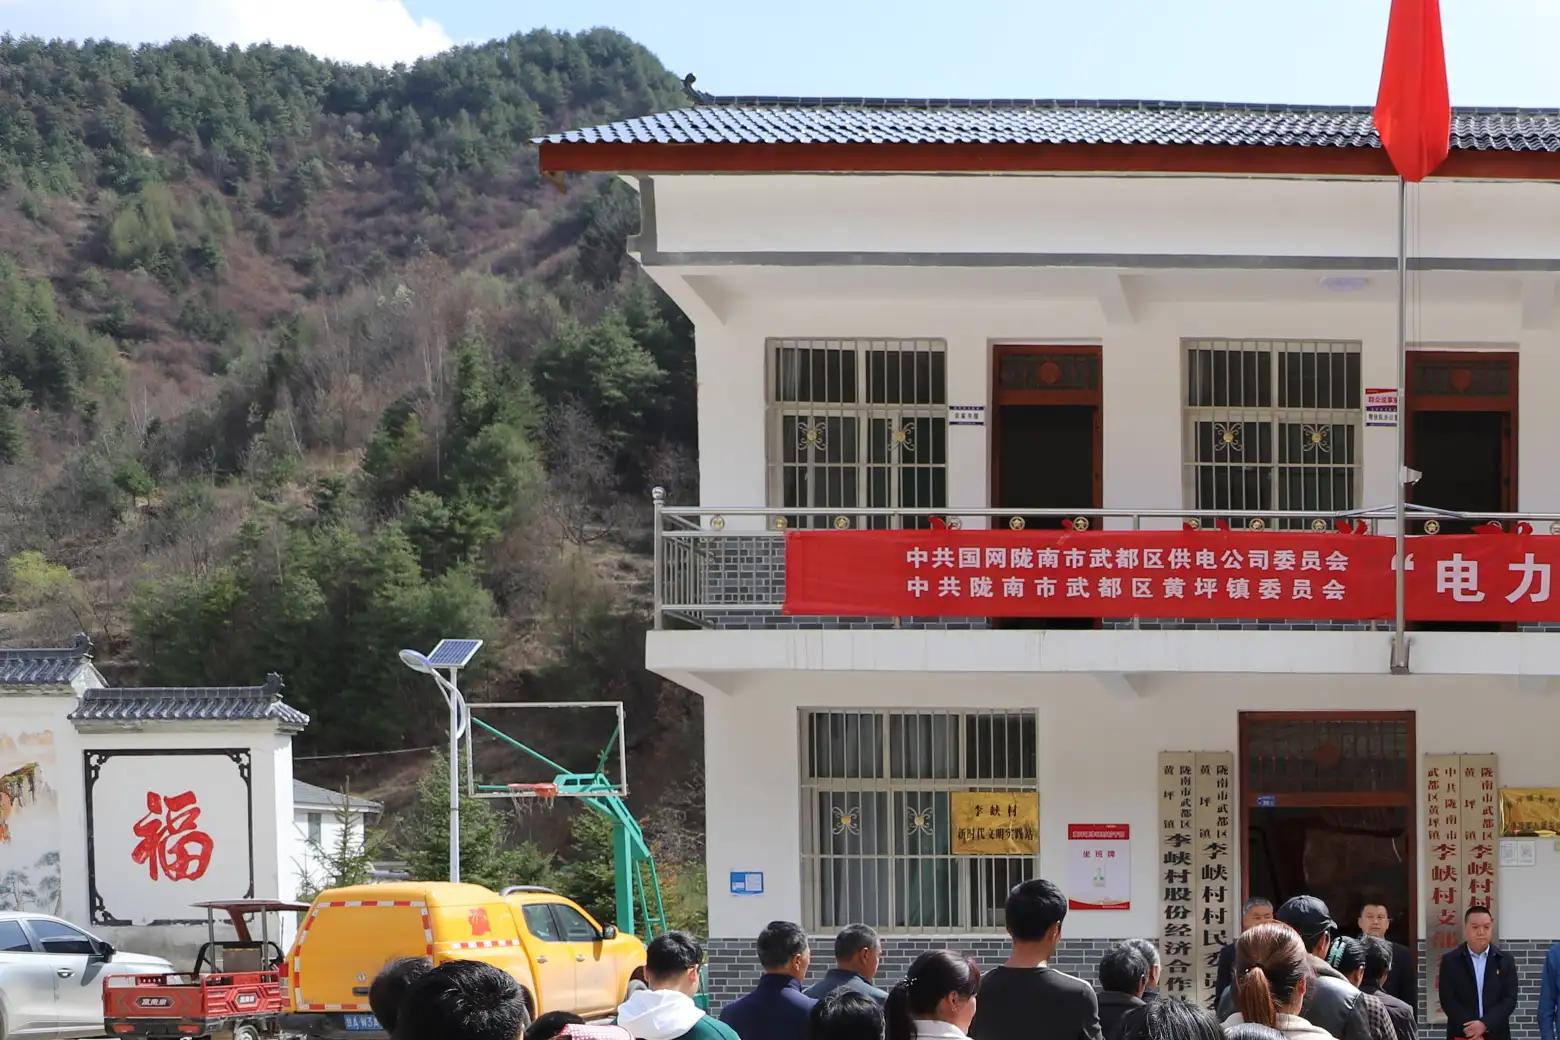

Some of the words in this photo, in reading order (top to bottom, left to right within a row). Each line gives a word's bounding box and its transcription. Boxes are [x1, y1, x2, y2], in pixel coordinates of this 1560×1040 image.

[906, 547, 1350, 572] 中共国网陇南市武都区供电公司委员会
[906, 576, 1347, 600] 中共陇南市武都区黄坪镇委员会
[131, 790, 214, 882] 福
